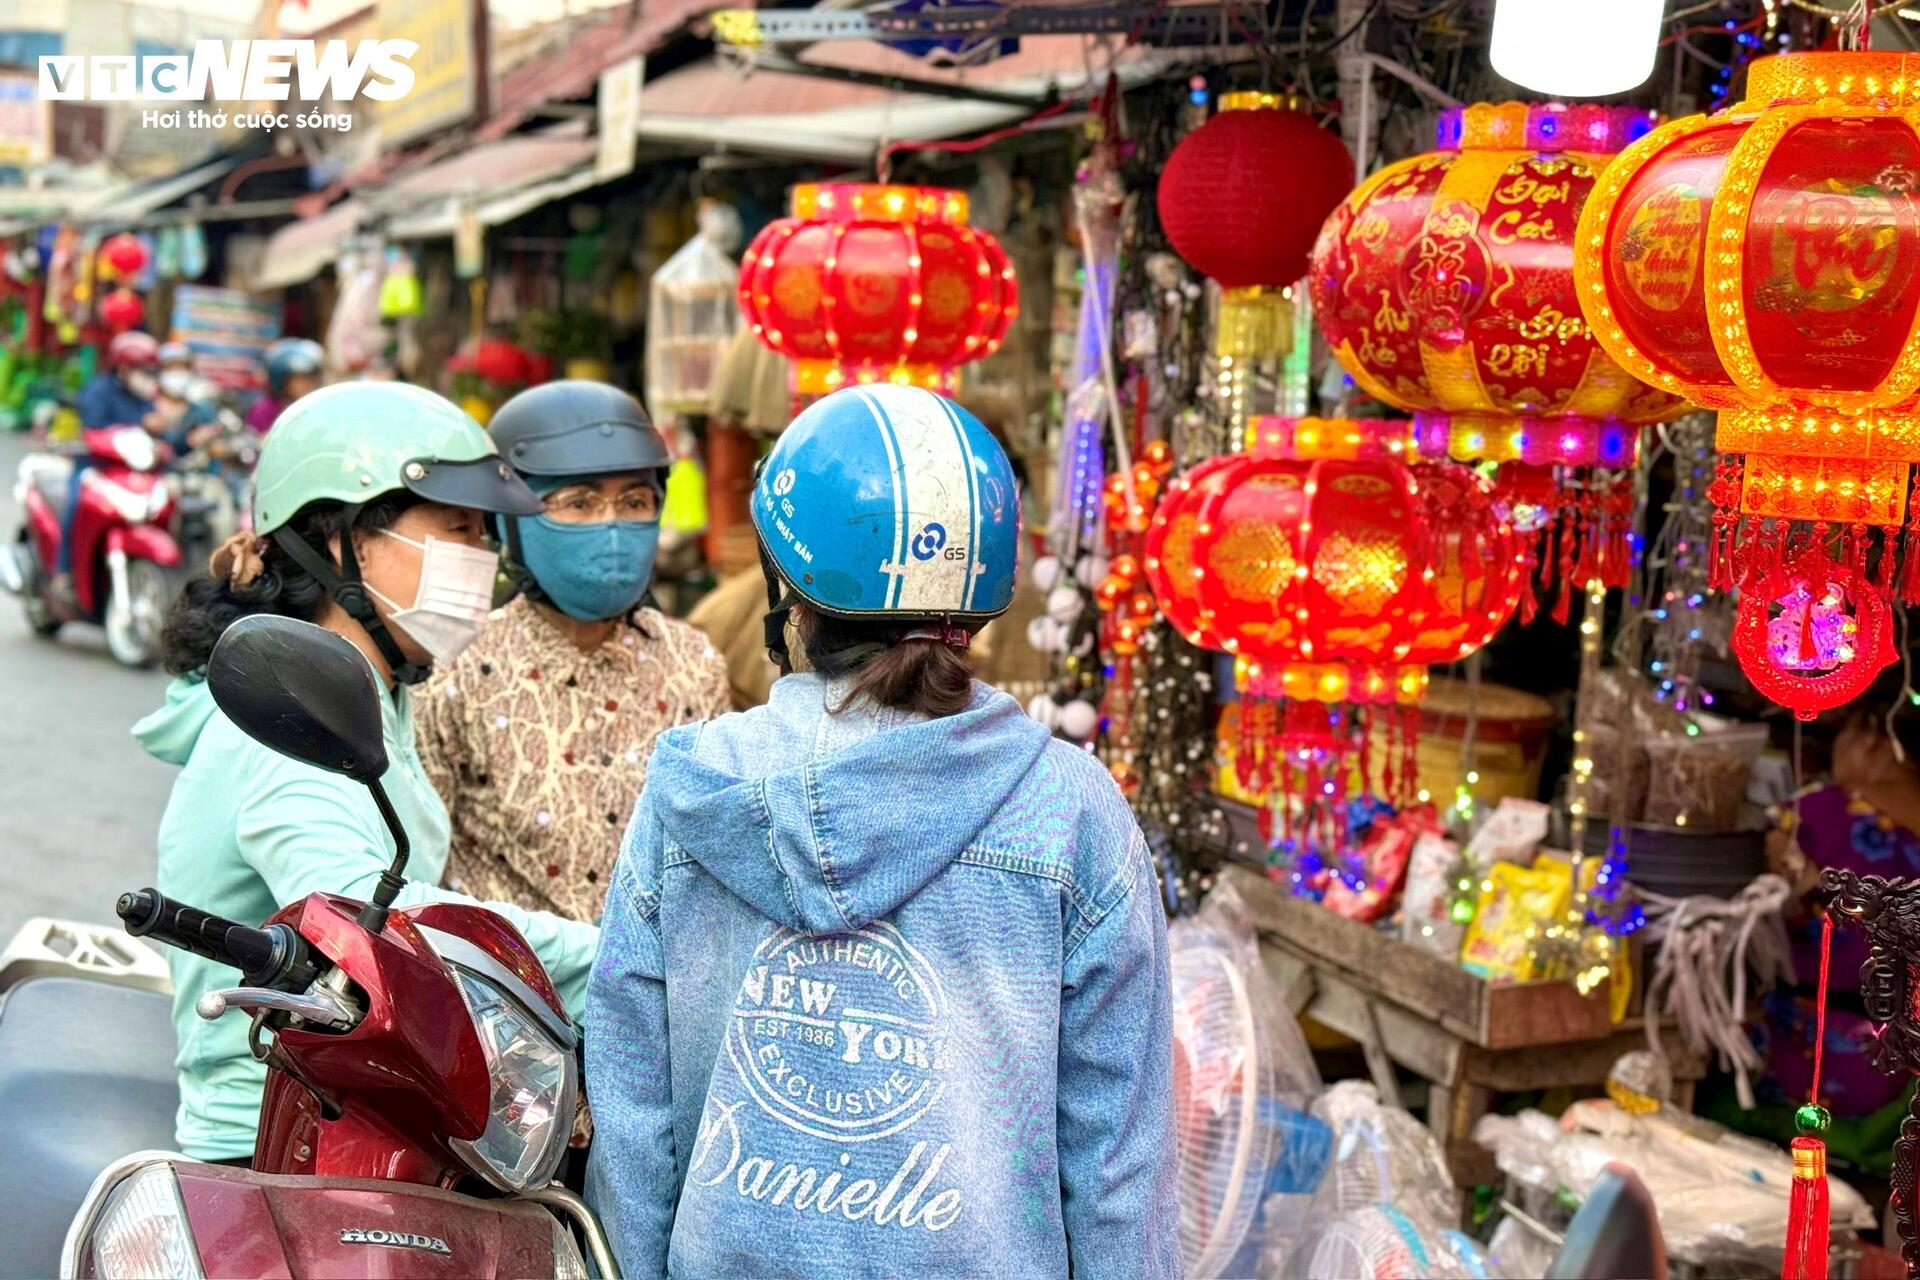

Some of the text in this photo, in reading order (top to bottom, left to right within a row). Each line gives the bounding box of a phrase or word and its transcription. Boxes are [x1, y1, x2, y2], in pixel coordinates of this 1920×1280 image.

[781, 498, 795, 518] GS
[944, 548, 965, 561] GS
[786, 939, 916, 1000] AUTHENTIC
[736, 966, 837, 1015] NEW
[753, 1019, 835, 1047] EST 1986
[758, 1042, 913, 1115] EXCLUSIVE
[690, 1094, 962, 1231] Danielle
[341, 1229, 452, 1254] HONDA
